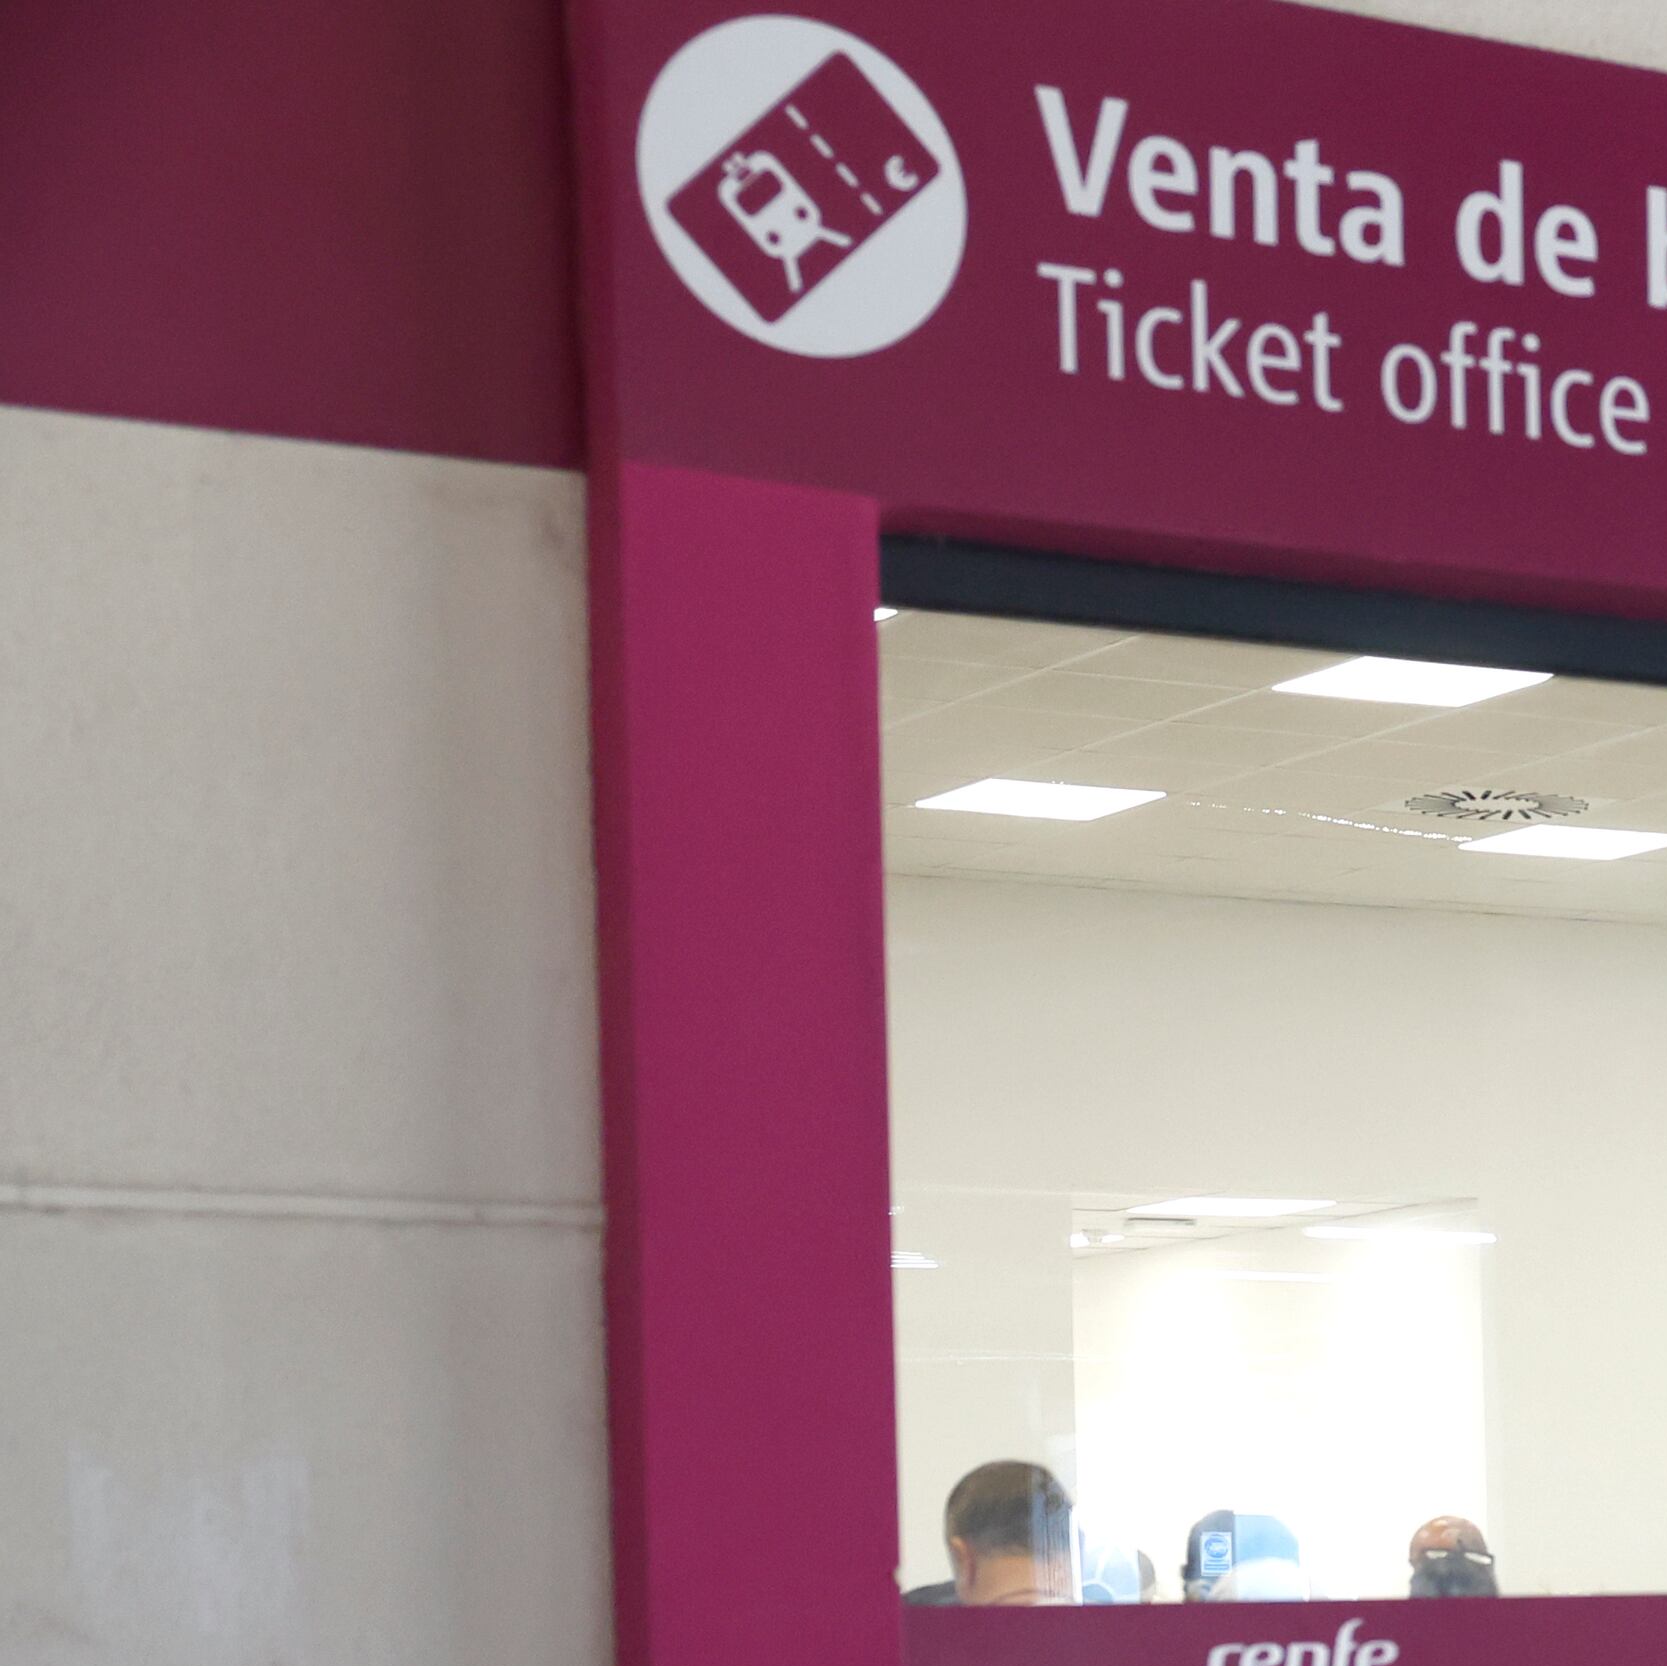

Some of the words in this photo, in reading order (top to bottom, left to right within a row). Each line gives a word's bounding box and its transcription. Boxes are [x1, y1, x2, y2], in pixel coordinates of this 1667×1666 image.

[1034, 85, 1404, 267] Venta
[1455, 159, 1598, 297] de
[1036, 262, 1343, 412] Ticket
[1380, 321, 1650, 455] office
